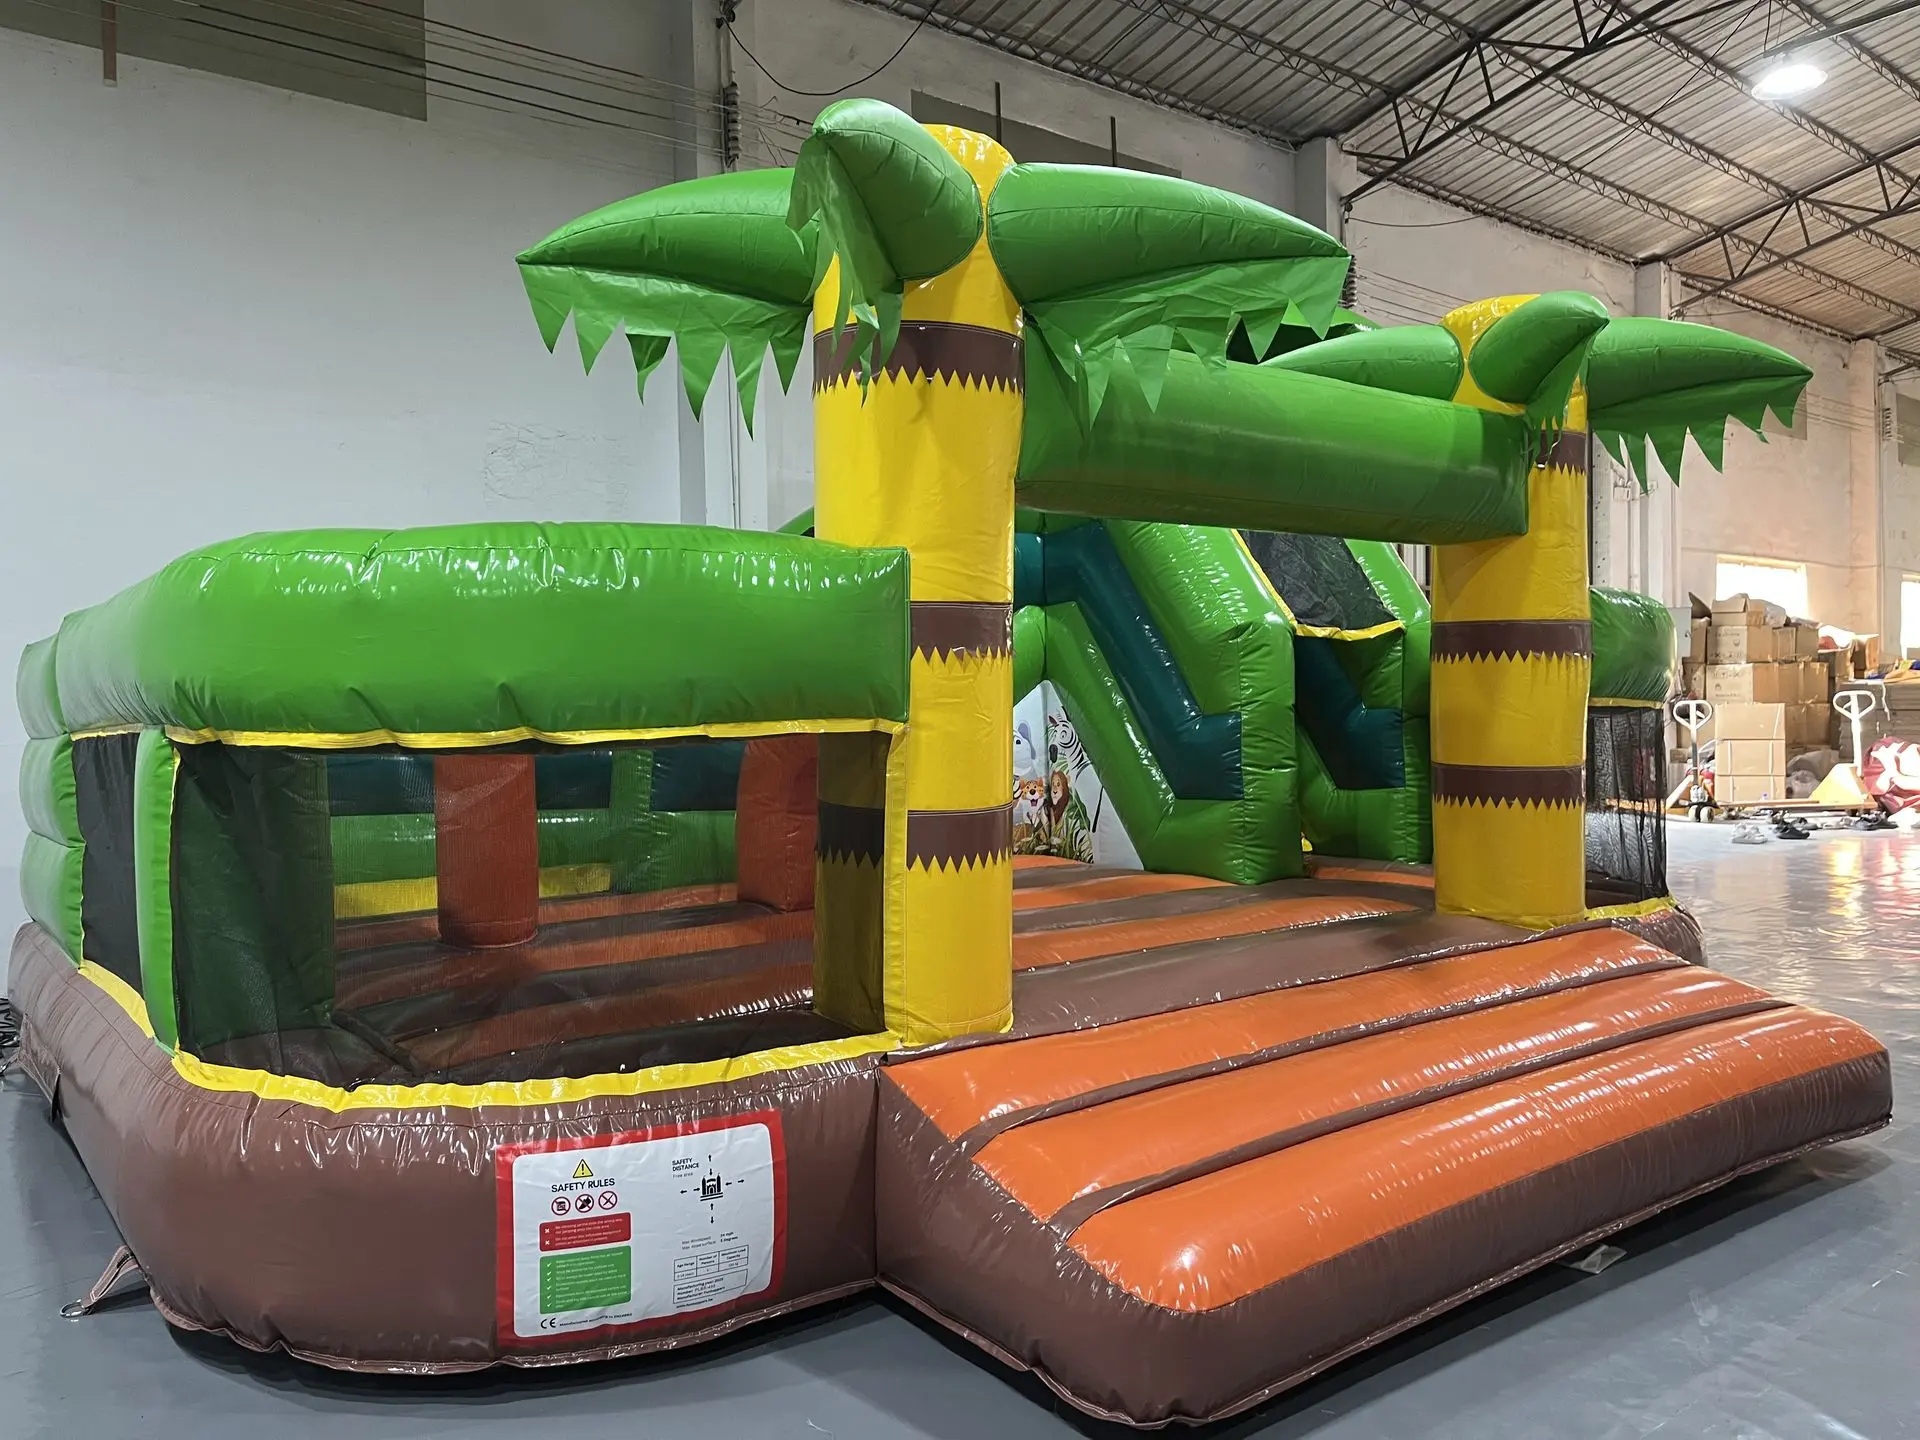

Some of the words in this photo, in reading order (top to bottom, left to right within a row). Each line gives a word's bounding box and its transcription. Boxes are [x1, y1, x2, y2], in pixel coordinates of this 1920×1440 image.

[672, 1162, 699, 1171] DISTANCE
[552, 1181, 585, 1192] SAFETY
[588, 1178, 615, 1189] RULES
[540, 1318, 556, 1329] CE
